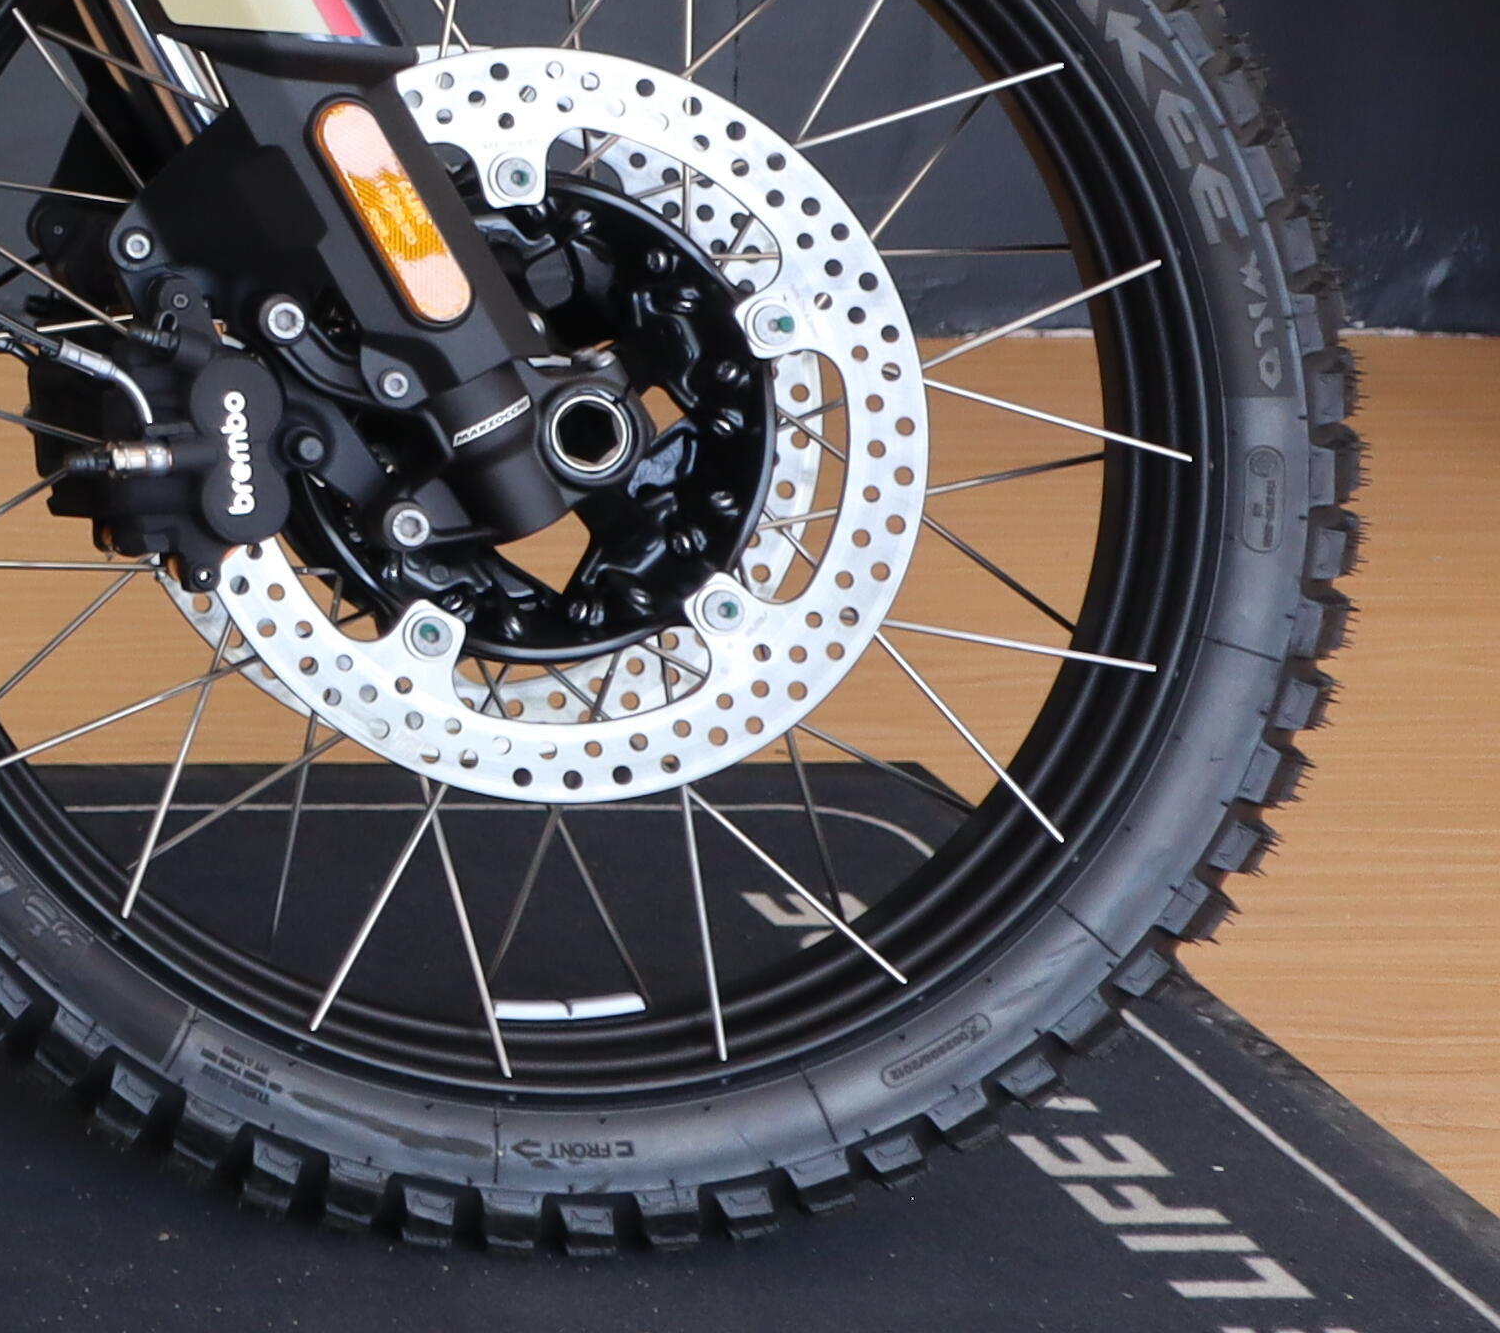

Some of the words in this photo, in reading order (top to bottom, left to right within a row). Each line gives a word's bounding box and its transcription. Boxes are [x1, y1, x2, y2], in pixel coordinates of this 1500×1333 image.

[1232, 250, 1283, 391] WILD
[226, 390, 255, 516] brembo
[546, 1136, 611, 1165] FRONT
[1007, 1133, 1317, 1300] LIFE
